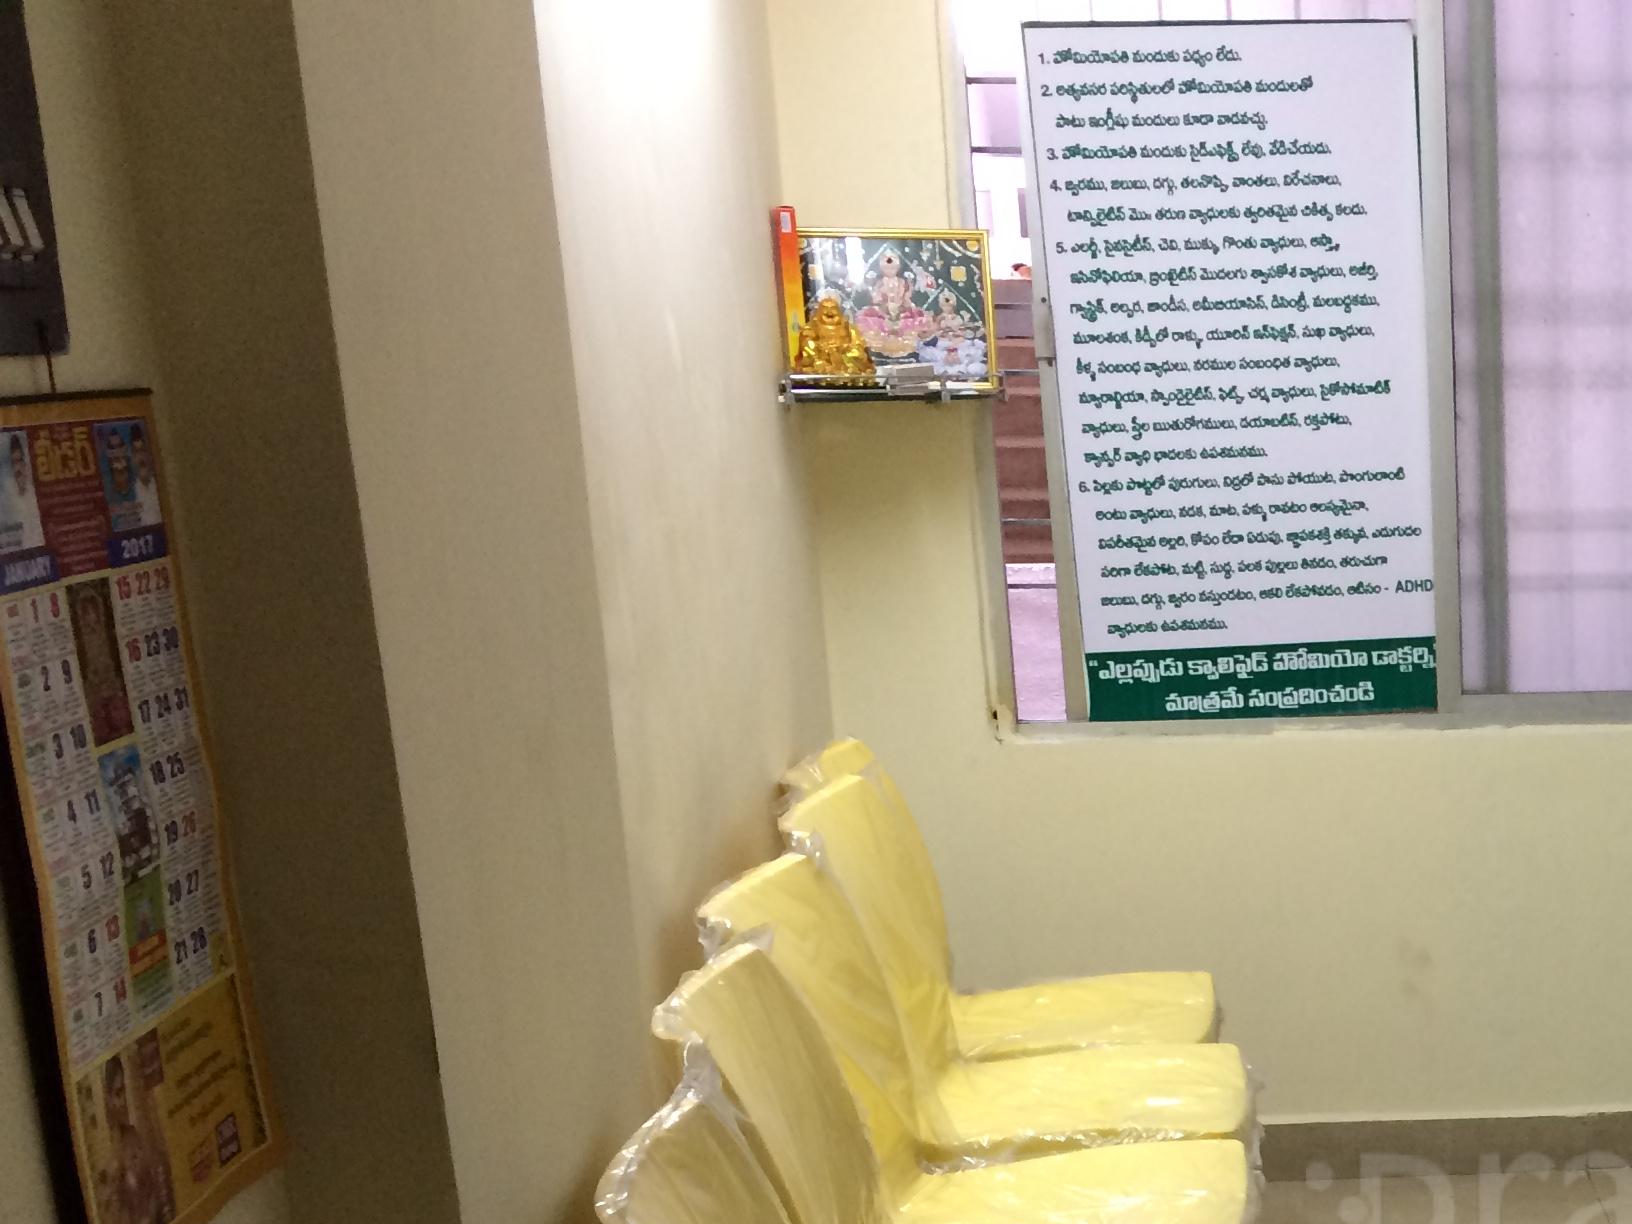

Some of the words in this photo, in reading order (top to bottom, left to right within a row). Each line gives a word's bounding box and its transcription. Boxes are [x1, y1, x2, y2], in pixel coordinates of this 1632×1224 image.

[1037, 52, 1051, 65] 1.
[1131, 113, 1181, 127] మందులు
[1046, 147, 1059, 161] 3.
[1055, 241, 1068, 255] 5.
[1078, 481, 1091, 493] 6.
[121, 534, 154, 559] 2017
[115, 576, 132, 601] 15
[1395, 578, 1434, 594] ADHD
[41, 665, 51, 692] 2
[1165, 686, 1244, 713] మాత్రమే
[52, 733, 63, 759] 3
[155, 693, 172, 718] 24
[67, 800, 77, 824] 4
[167, 752, 185, 776] 25
[81, 865, 92, 890] 5
